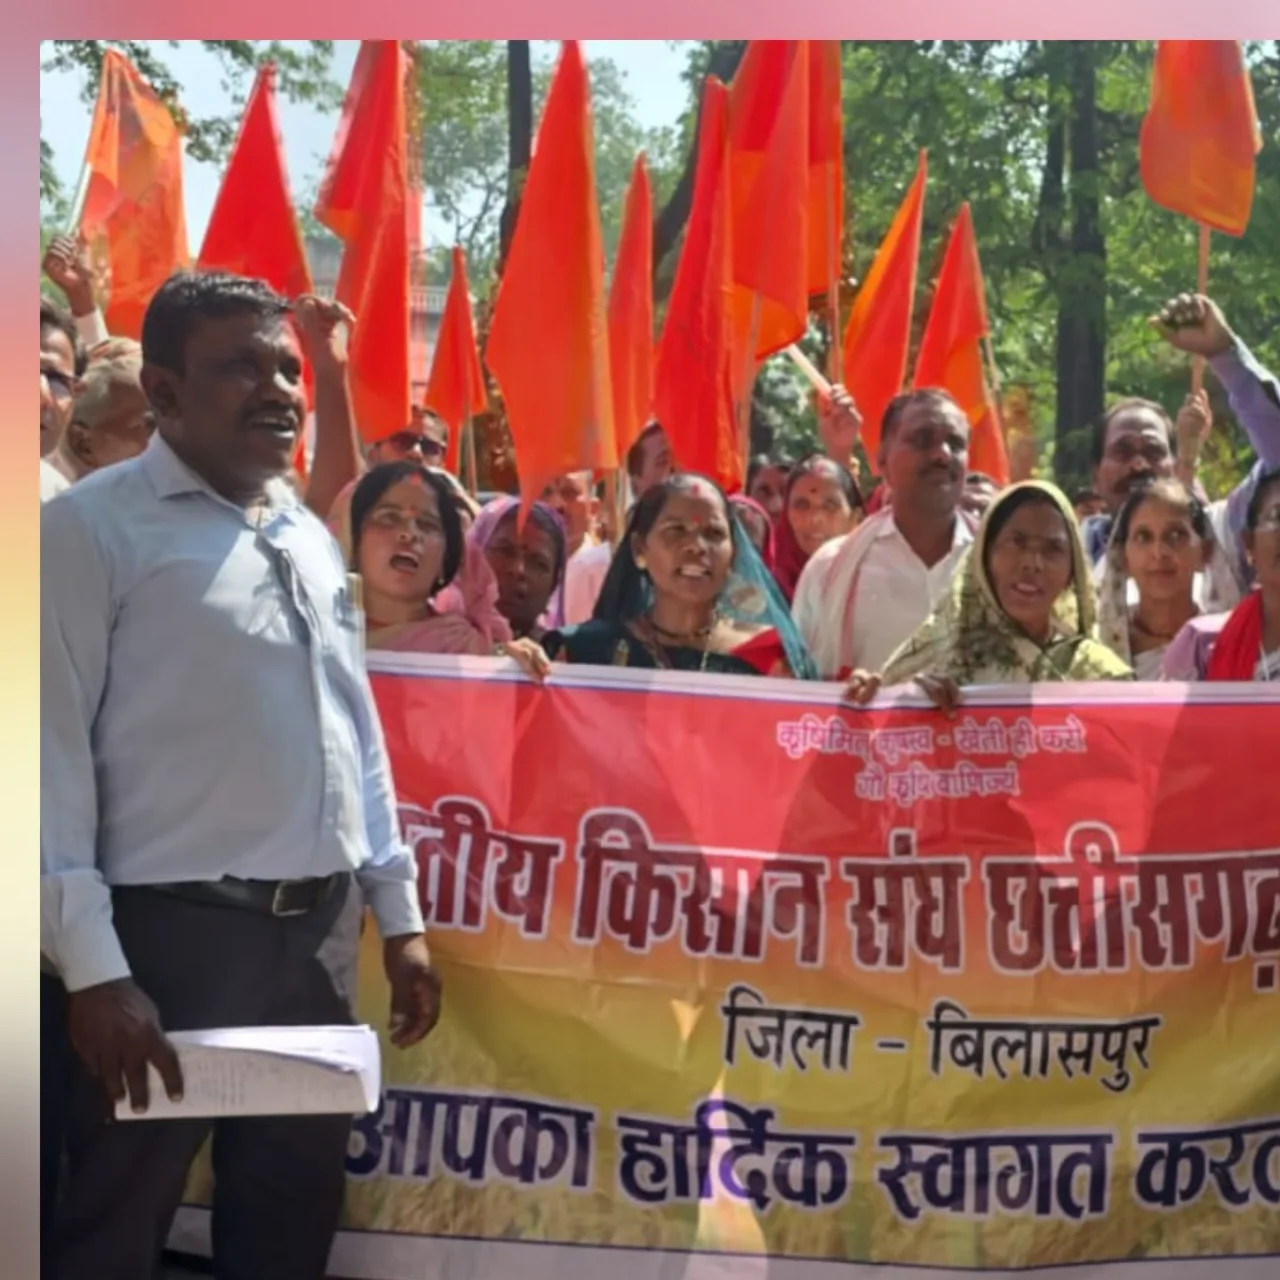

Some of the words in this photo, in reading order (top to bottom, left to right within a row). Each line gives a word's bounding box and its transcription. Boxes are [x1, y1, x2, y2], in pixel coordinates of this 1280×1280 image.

[397, 797, 563, 936] तीय
[576, 808, 828, 965] किसान
[842, 829, 968, 971] संघ
[722, 986, 858, 1070] जिला
[927, 1002, 1160, 1092] बिलासपुर
[345, 1089, 595, 1182] आपका
[616, 1100, 856, 1209] हार्दिक
[877, 1135, 1113, 1220] स्वागत
